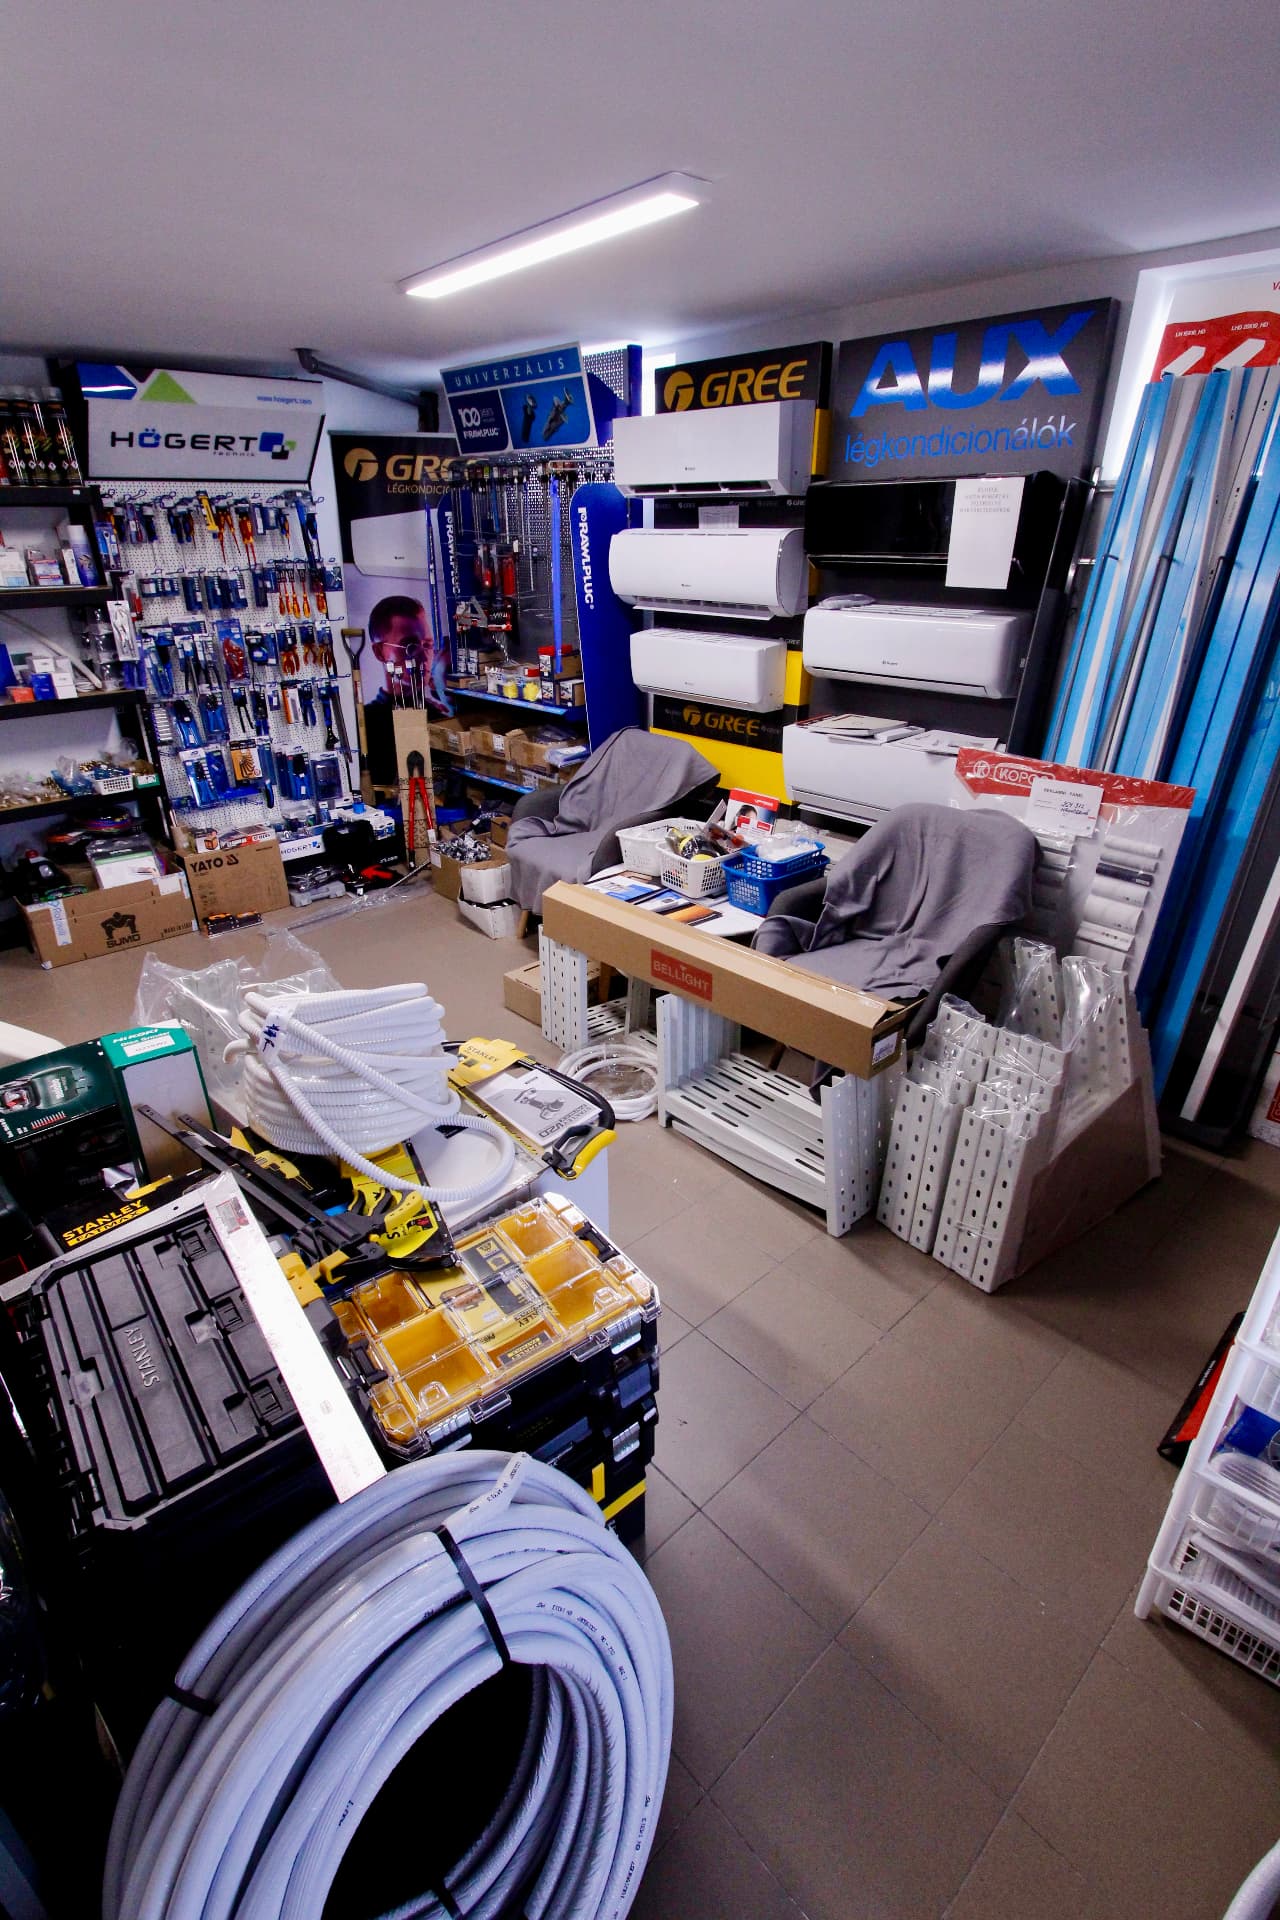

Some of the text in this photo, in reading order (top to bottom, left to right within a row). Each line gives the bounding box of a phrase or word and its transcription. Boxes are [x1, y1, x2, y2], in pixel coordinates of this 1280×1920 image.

[455, 357, 565, 387] UNIVERZÁLIS
[850, 310, 1096, 417] AUX
[701, 360, 807, 407] GREE
[458, 407, 480, 428] 100
[111, 428, 258, 452] HÖGERT
[844, 415, 1078, 467] légkondicionálók
[579, 522, 594, 604] RAWLPLUG
[704, 711, 760, 737] GREE
[190, 857, 224, 873] YATO
[106, 934, 141, 948] SUMO
[654, 961, 709, 992] BELLIGHT
[466, 1045, 498, 1062] STANLEY
[62, 1199, 141, 1240] STANLEY
[124, 1327, 160, 1388] STANLEY
